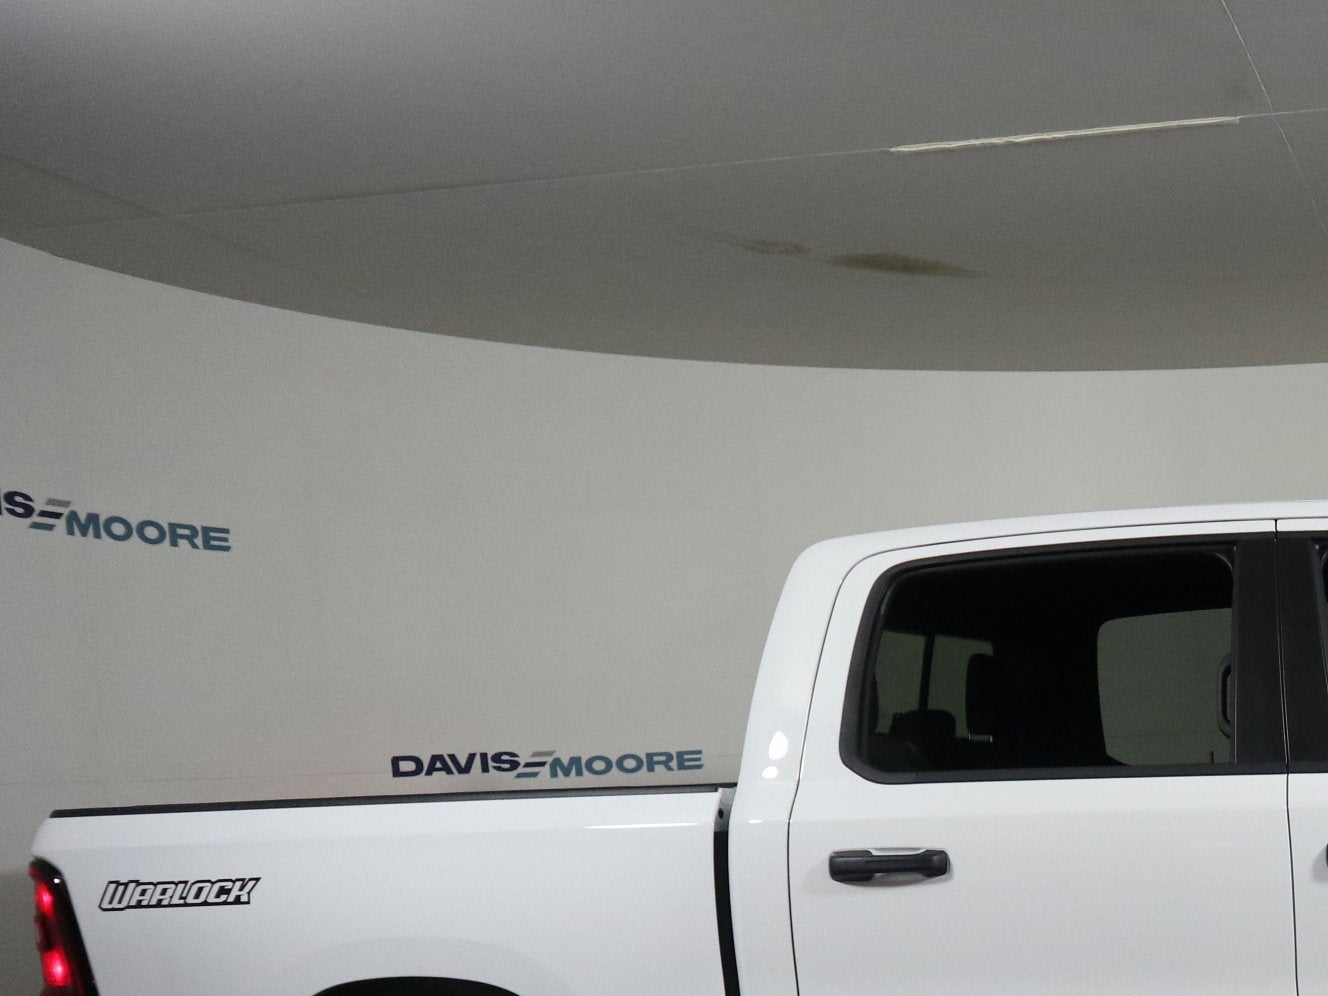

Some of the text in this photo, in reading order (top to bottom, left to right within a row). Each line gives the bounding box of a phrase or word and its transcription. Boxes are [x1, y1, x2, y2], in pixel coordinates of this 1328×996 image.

[65, 509, 231, 552] MOORE
[390, 749, 704, 779] DAVIS MOORE
[98, 877, 261, 911] WARLOCK
